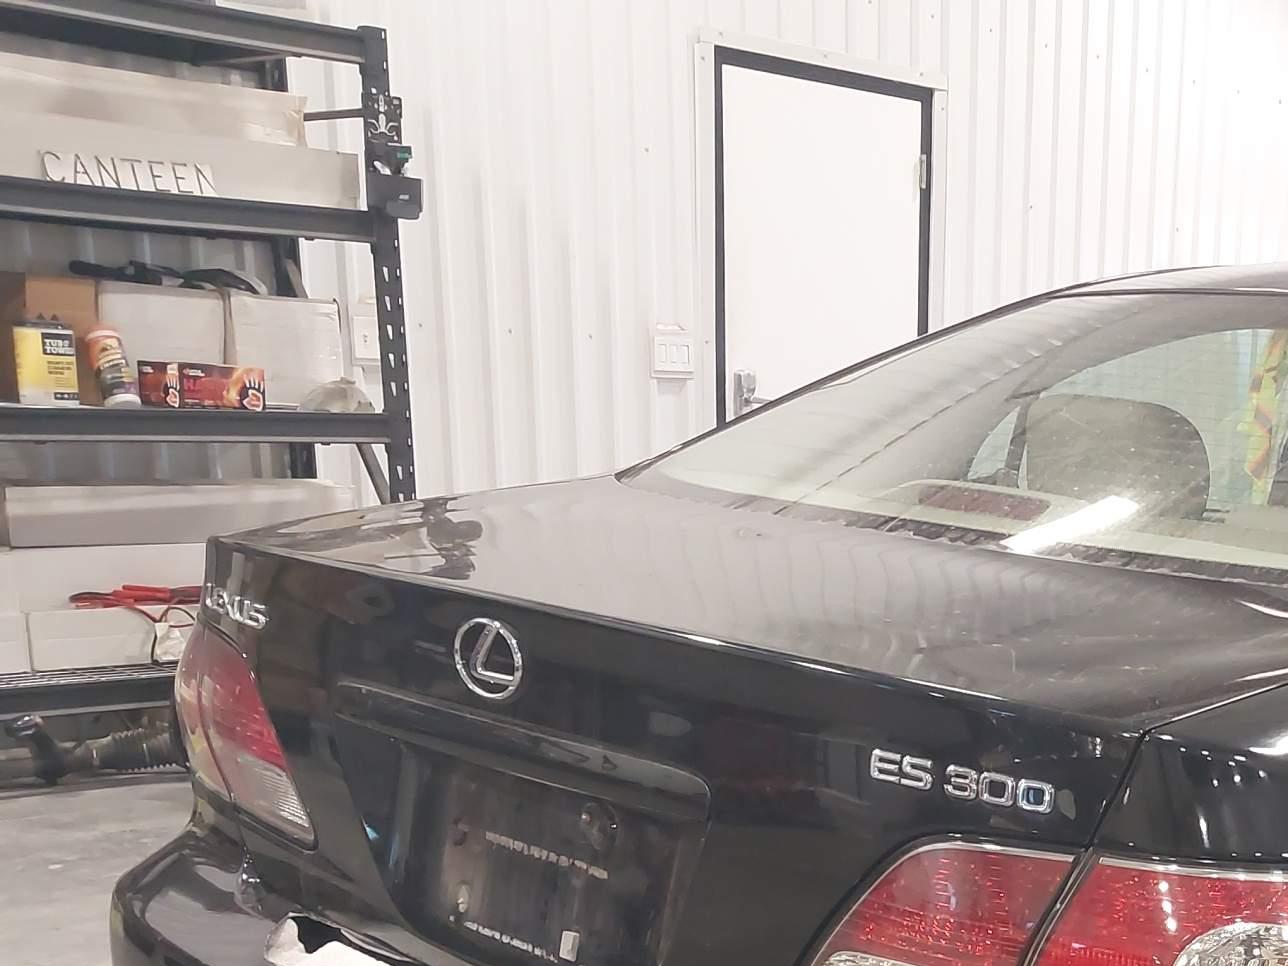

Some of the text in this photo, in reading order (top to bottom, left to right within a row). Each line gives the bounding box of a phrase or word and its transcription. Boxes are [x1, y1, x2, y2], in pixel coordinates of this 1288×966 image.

[38, 150, 217, 195] CANTEEN
[205, 583, 269, 631] LEXUS
[870, 748, 1056, 814] ES 300
